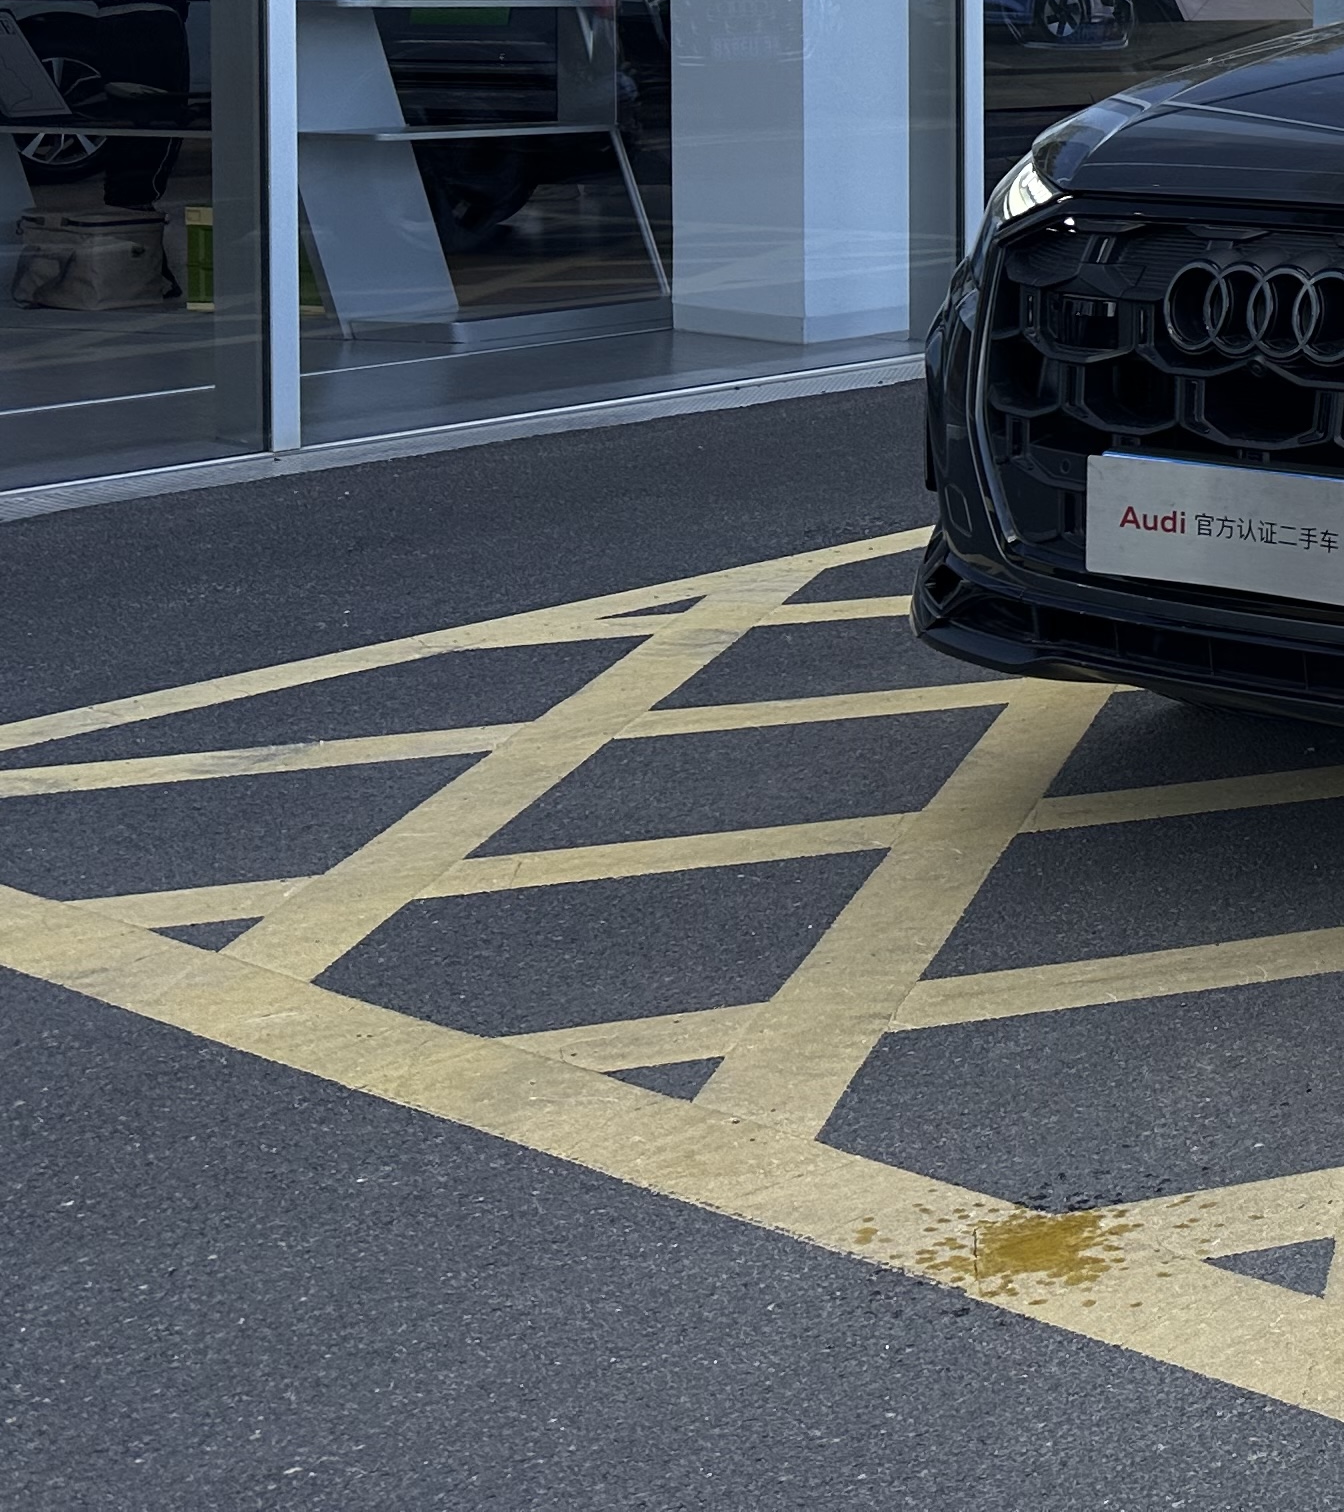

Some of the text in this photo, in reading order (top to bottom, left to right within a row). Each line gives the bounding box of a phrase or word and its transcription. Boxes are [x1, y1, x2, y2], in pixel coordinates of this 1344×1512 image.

[1119, 505, 1340, 554] Audi 官方认证二手车
